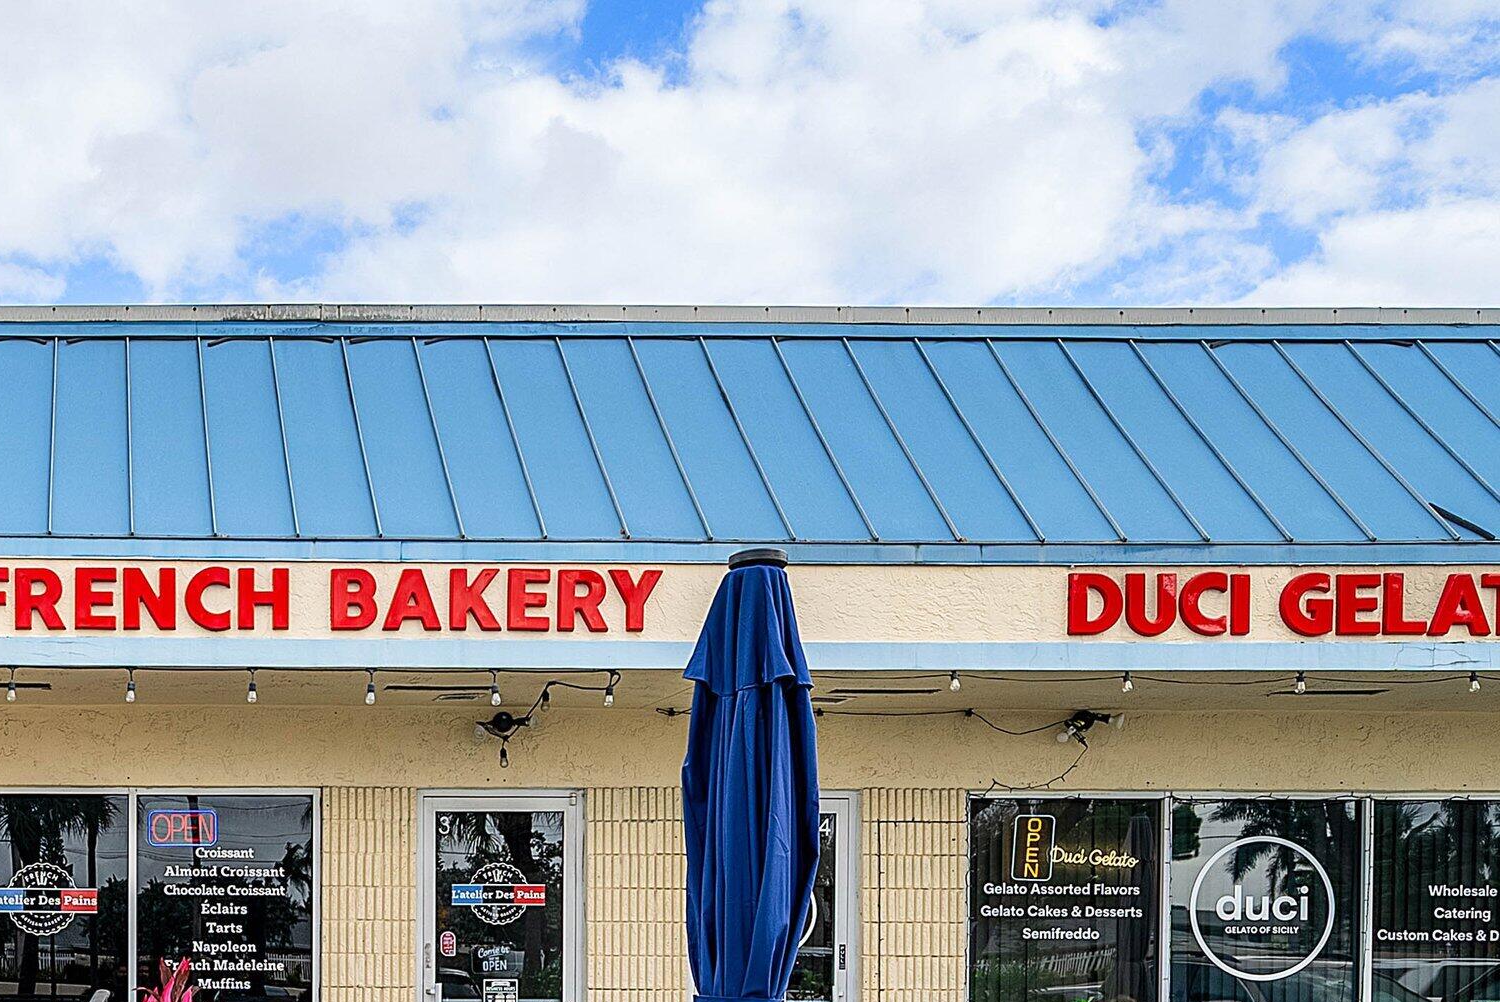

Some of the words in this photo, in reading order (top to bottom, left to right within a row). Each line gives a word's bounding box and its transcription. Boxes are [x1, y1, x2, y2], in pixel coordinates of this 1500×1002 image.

[329, 568, 664, 632] BAKERY
[1067, 572, 1250, 637] DUCI
[152, 813, 214, 842] OPEN
[438, 816, 450, 834] 3
[819, 818, 831, 836] 4
[195, 847, 254, 858] Croissant
[1024, 817, 1042, 878] OPEN
[1050, 845, 1088, 865] Duci
[1089, 849, 1139, 868] Gelato
[25, 871, 59, 882] FRENCH
[164, 866, 217, 877] Almond
[220, 866, 285, 877] Croissant
[164, 884, 225, 896] Chocolate
[227, 885, 286, 896] Croissant
[452, 890, 493, 899] L'atelier
[495, 890, 515, 899] Des
[517, 890, 545, 899] Pains
[983, 882, 1028, 895] Gelato
[1030, 882, 1091, 895] Assorted
[1094, 883, 1140, 896] Flavors
[1428, 884, 1498, 897] Wholesale
[38, 895, 61, 905] Des
[64, 895, 97, 906] Pains
[201, 899, 248, 915] Éclairs
[1216, 884, 1309, 921] duci
[980, 905, 1025, 917] Gelato
[1027, 905, 1068, 917] Cakes
[1071, 906, 1082, 917] &
[1085, 906, 1143, 918] Desserts
[1434, 907, 1491, 922] Catering
[206, 922, 243, 933] Tarts
[1022, 928, 1100, 940] Semifreddo
[1224, 926, 1258, 934] GELATO
[1259, 926, 1271, 934] OF
[1272, 926, 1299, 934] SICILY
[1377, 929, 1429, 941] Custom
[1432, 929, 1473, 941] Cakes
[1476, 930, 1487, 941] &
[192, 941, 257, 955] Napoleon
[164, 959, 211, 971] Frnch
[213, 959, 285, 971] Madeleine
[482, 960, 507, 971] OPEN
[198, 978, 251, 990] Muffins
